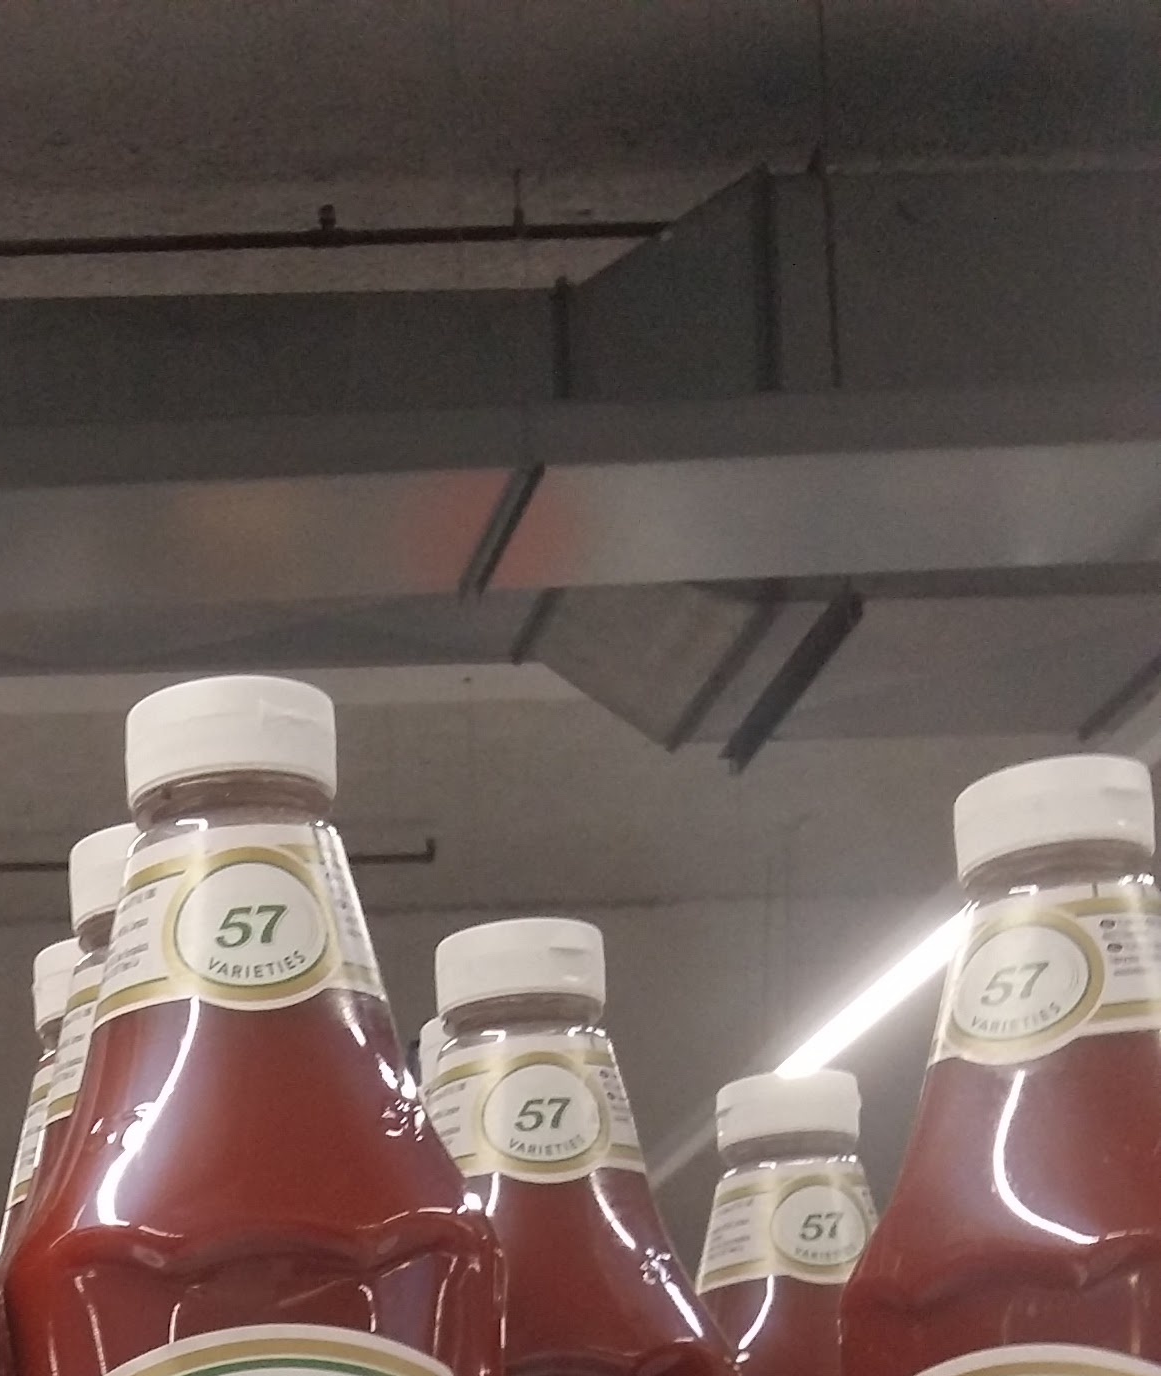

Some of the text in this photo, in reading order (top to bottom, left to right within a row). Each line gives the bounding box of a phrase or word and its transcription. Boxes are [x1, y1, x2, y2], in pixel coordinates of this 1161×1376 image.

[215, 905, 289, 948] 57
[207, 949, 307, 980] VARIETIES
[981, 960, 1050, 1007] 57
[971, 1001, 1063, 1034] VARIETIES
[515, 1098, 571, 1132] 57
[800, 1212, 845, 1242] 57
